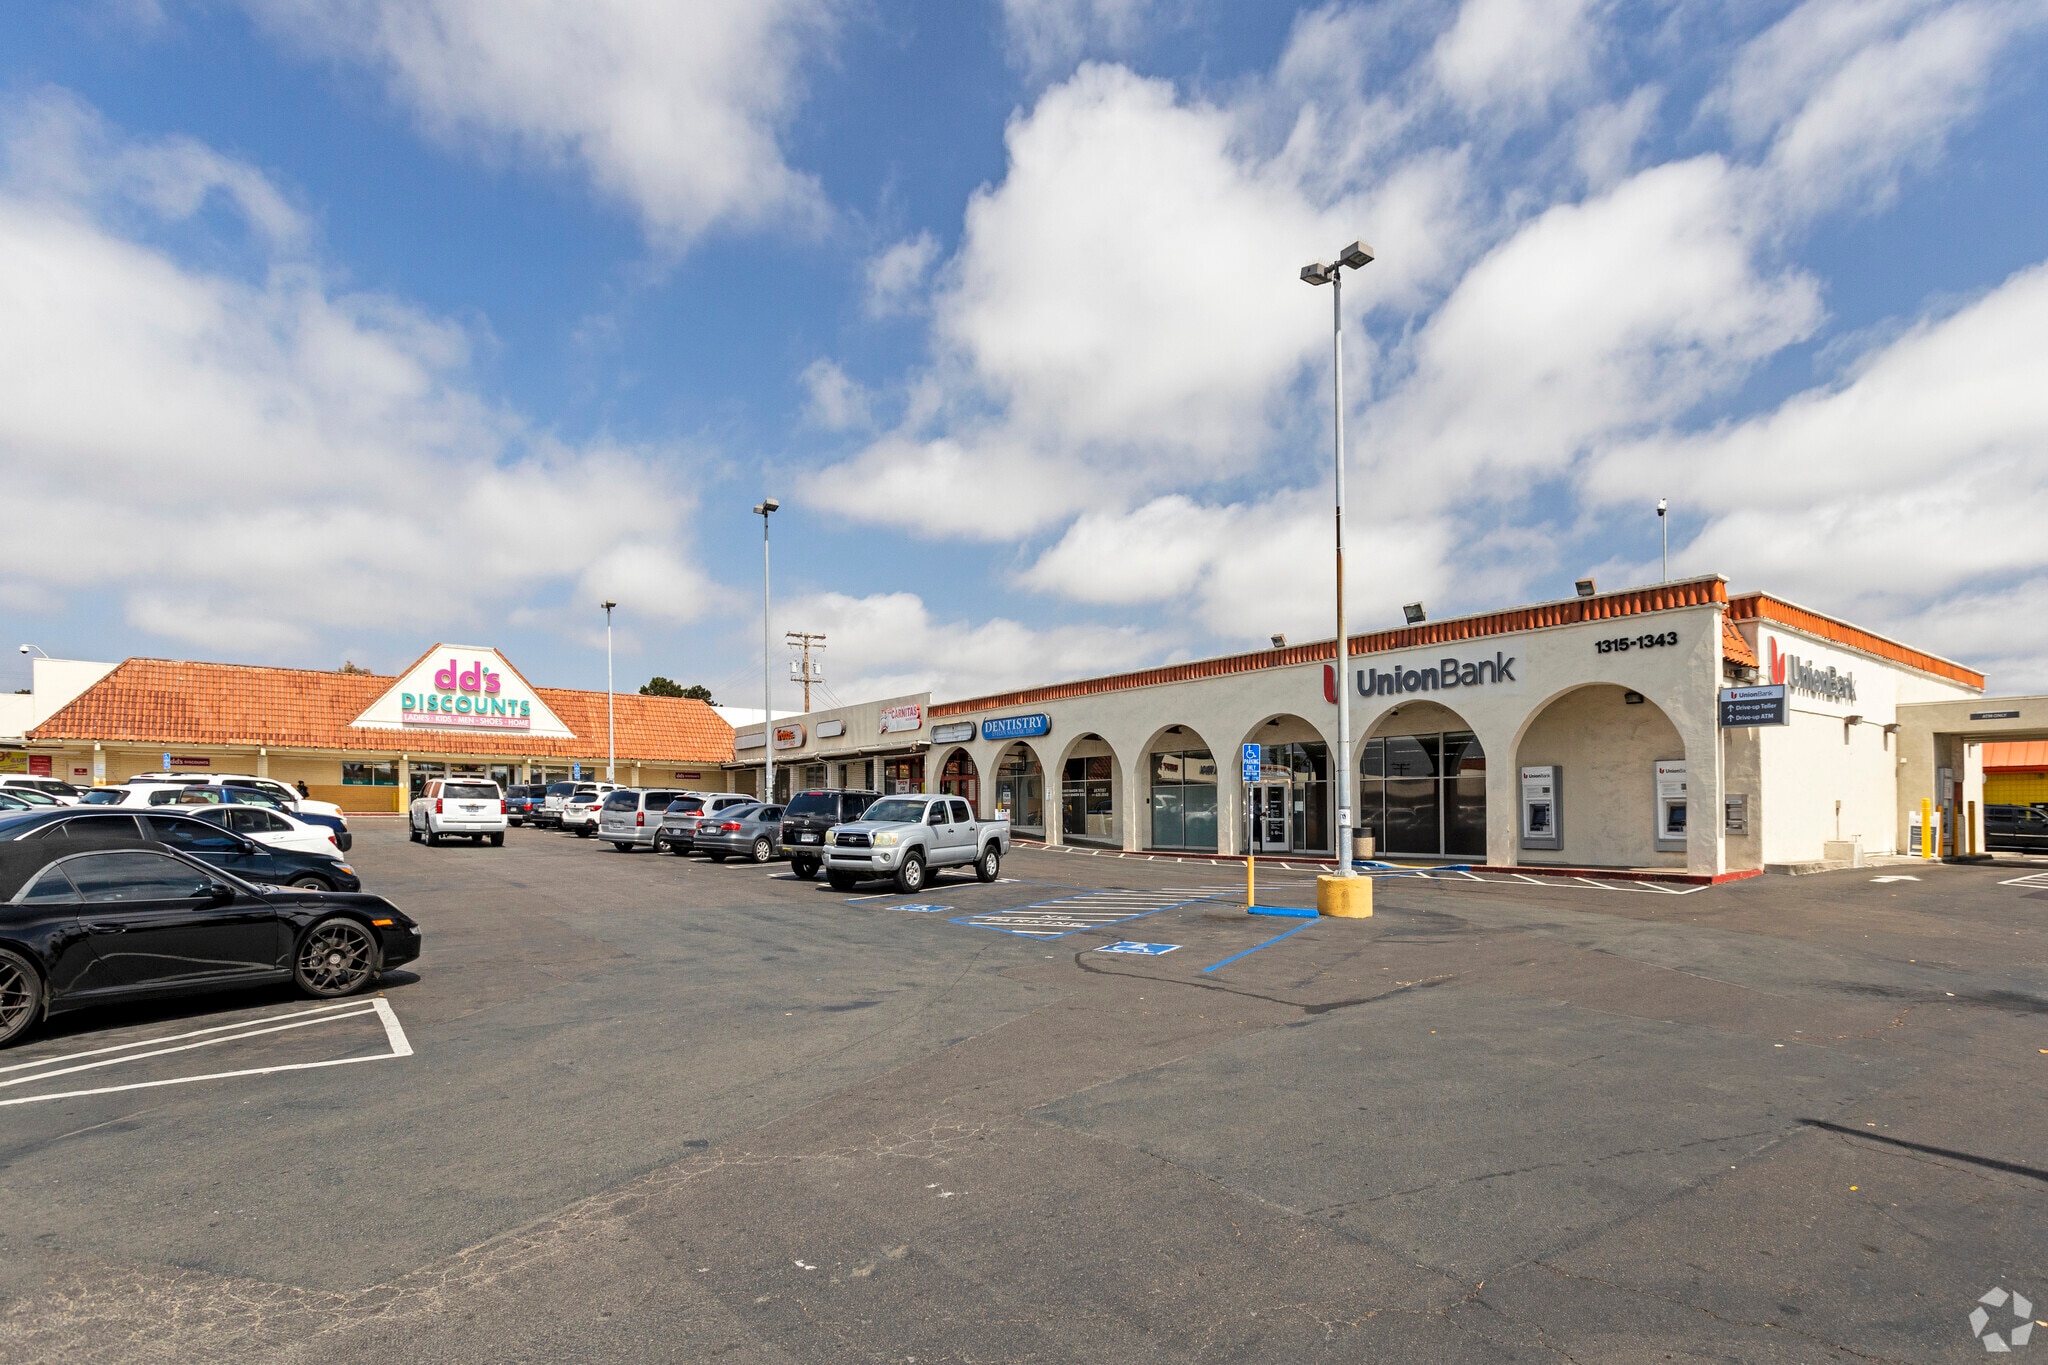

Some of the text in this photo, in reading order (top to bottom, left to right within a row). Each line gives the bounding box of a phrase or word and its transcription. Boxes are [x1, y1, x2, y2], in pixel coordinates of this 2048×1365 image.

[1595, 632, 1678, 654] 1315-1343
[434, 659, 501, 693] dd's
[1357, 652, 1516, 697] UnionBank
[1787, 654, 1857, 702] UnionBank
[1738, 690, 1773, 698] UnionBank
[401, 692, 531, 716] DISCOUNTS
[1735, 702, 1777, 711] Drive-up Teller
[404, 713, 529, 727] LADIES KIDS MEN SHOES HOME
[890, 706, 918, 720] CARNITAS
[985, 716, 1044, 733] DENTISTRY
[984, 917, 1086, 926] PARKING
